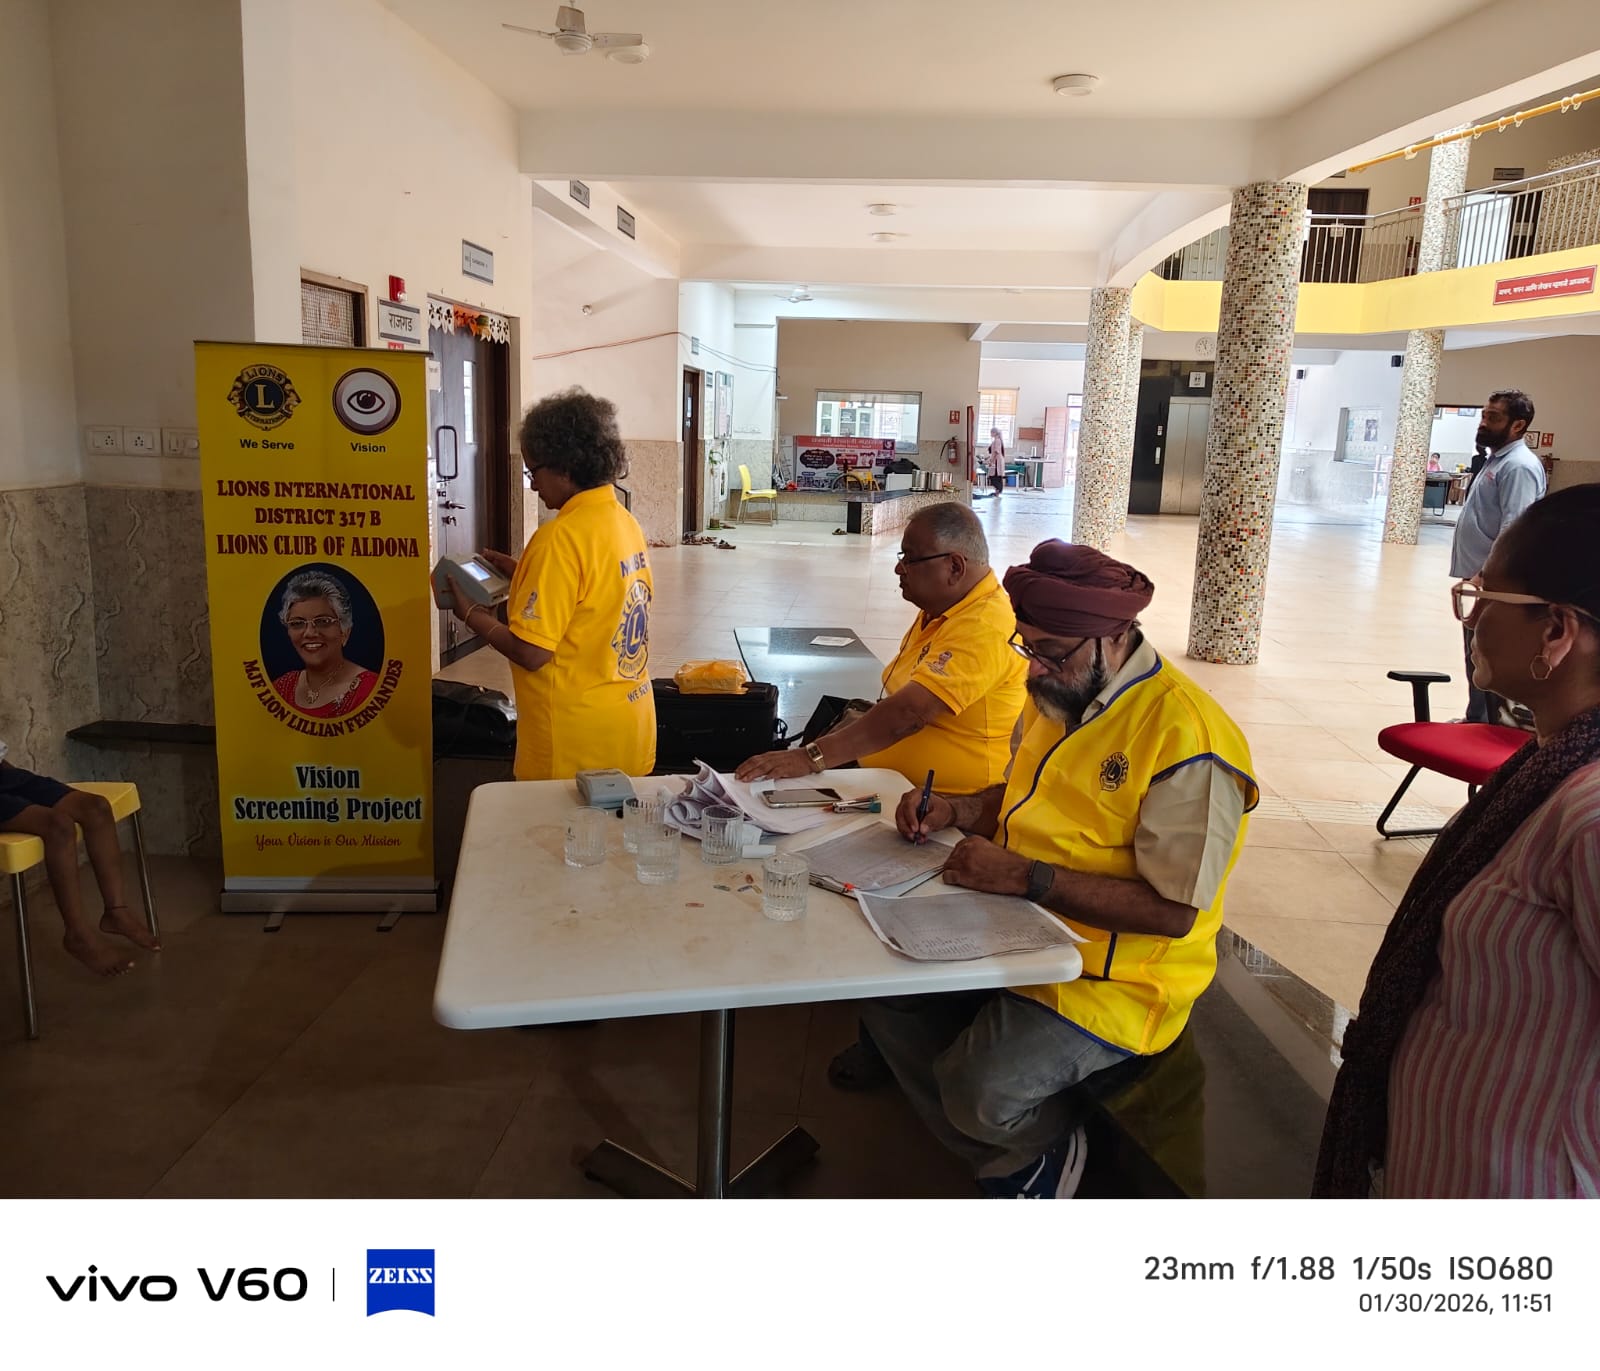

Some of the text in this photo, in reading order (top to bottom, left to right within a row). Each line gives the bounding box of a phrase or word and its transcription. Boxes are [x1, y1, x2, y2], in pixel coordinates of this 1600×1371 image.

[388, 312, 413, 332] राजगड
[247, 367, 284, 383] LIONS
[255, 384, 275, 409] L
[239, 438, 295, 450] We Serve
[350, 443, 387, 453] Vision
[217, 480, 416, 501] LIONS INTERNATIONAL
[255, 508, 382, 528] DISTRICT 317 B
[216, 534, 420, 558] LIONS CLUB OF ALDONA
[630, 612, 641, 646] L
[242, 659, 403, 738] MJF LION LILLIAN FERNANDES
[296, 766, 360, 789] Vision
[234, 797, 422, 823] Screening Project
[255, 833, 402, 851] Your Vision is Our Mission
